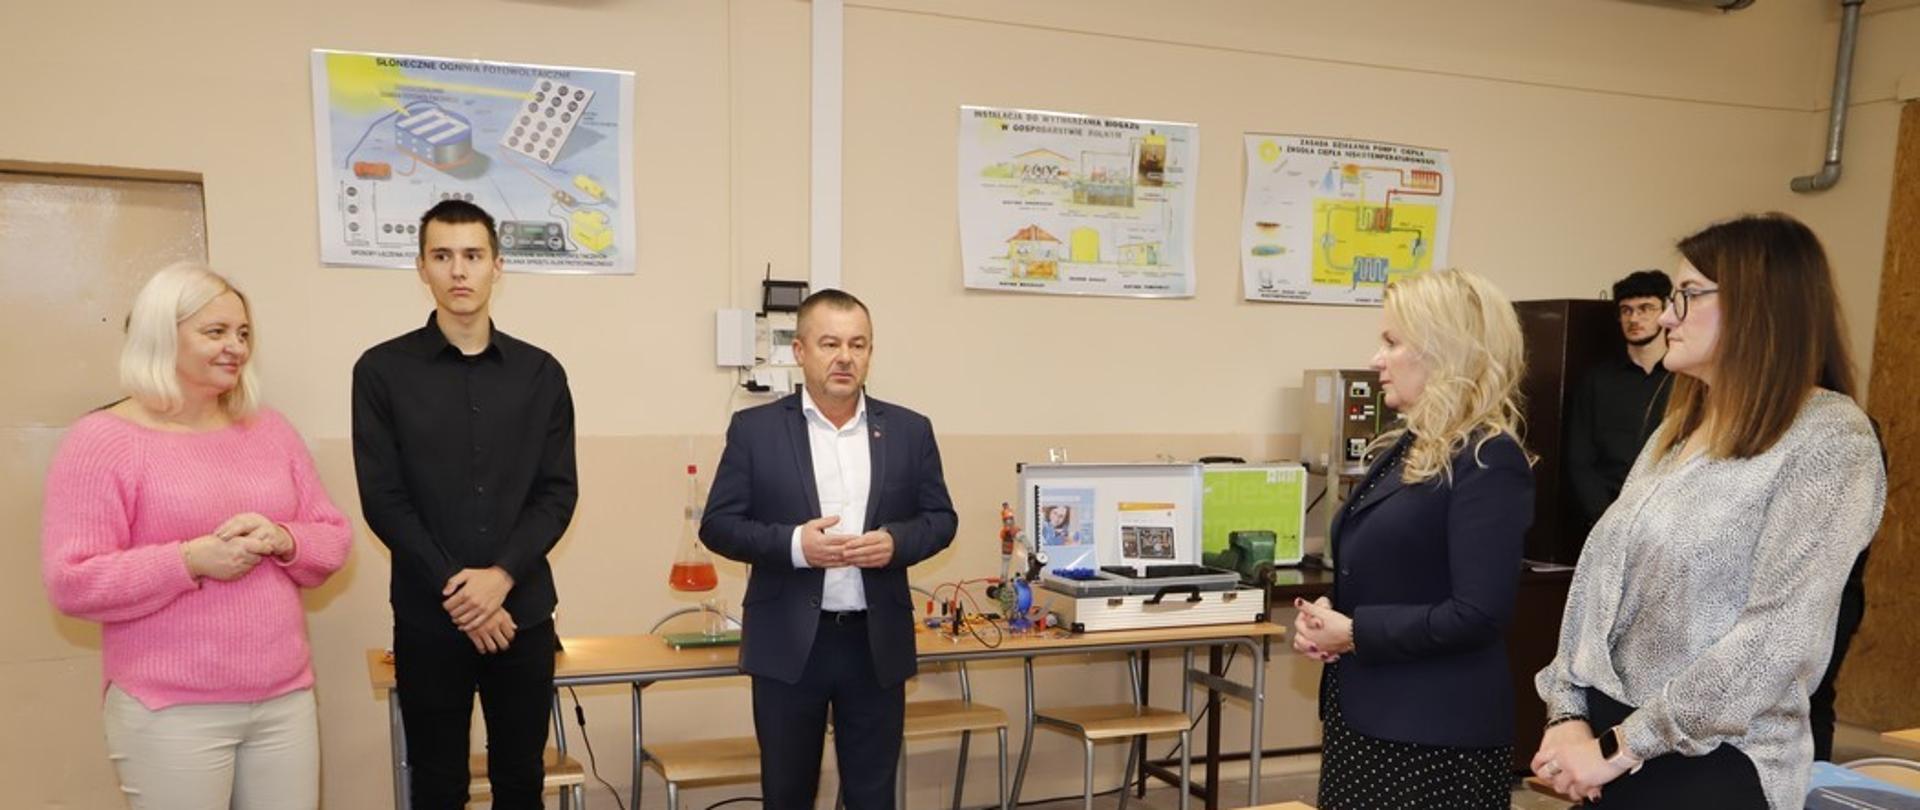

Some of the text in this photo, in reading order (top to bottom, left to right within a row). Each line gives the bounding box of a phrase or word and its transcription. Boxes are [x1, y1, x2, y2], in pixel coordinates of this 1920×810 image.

[376, 57, 571, 79] SŁONECZNE OGNIWA FOTOWOLTAICZNE
[974, 110, 1140, 130] INSTALACJA DO WYTWARZANIA BIOGAZU
[1001, 123, 1009, 131] W
[1012, 124, 1083, 137] GOSPODARSTWIE
[1300, 139, 1329, 148] ZASADA
[1332, 141, 1370, 151] DZIAŁANIA
[1373, 144, 1397, 154] POMPY
[1318, 148, 1342, 157] CIEPŁA
